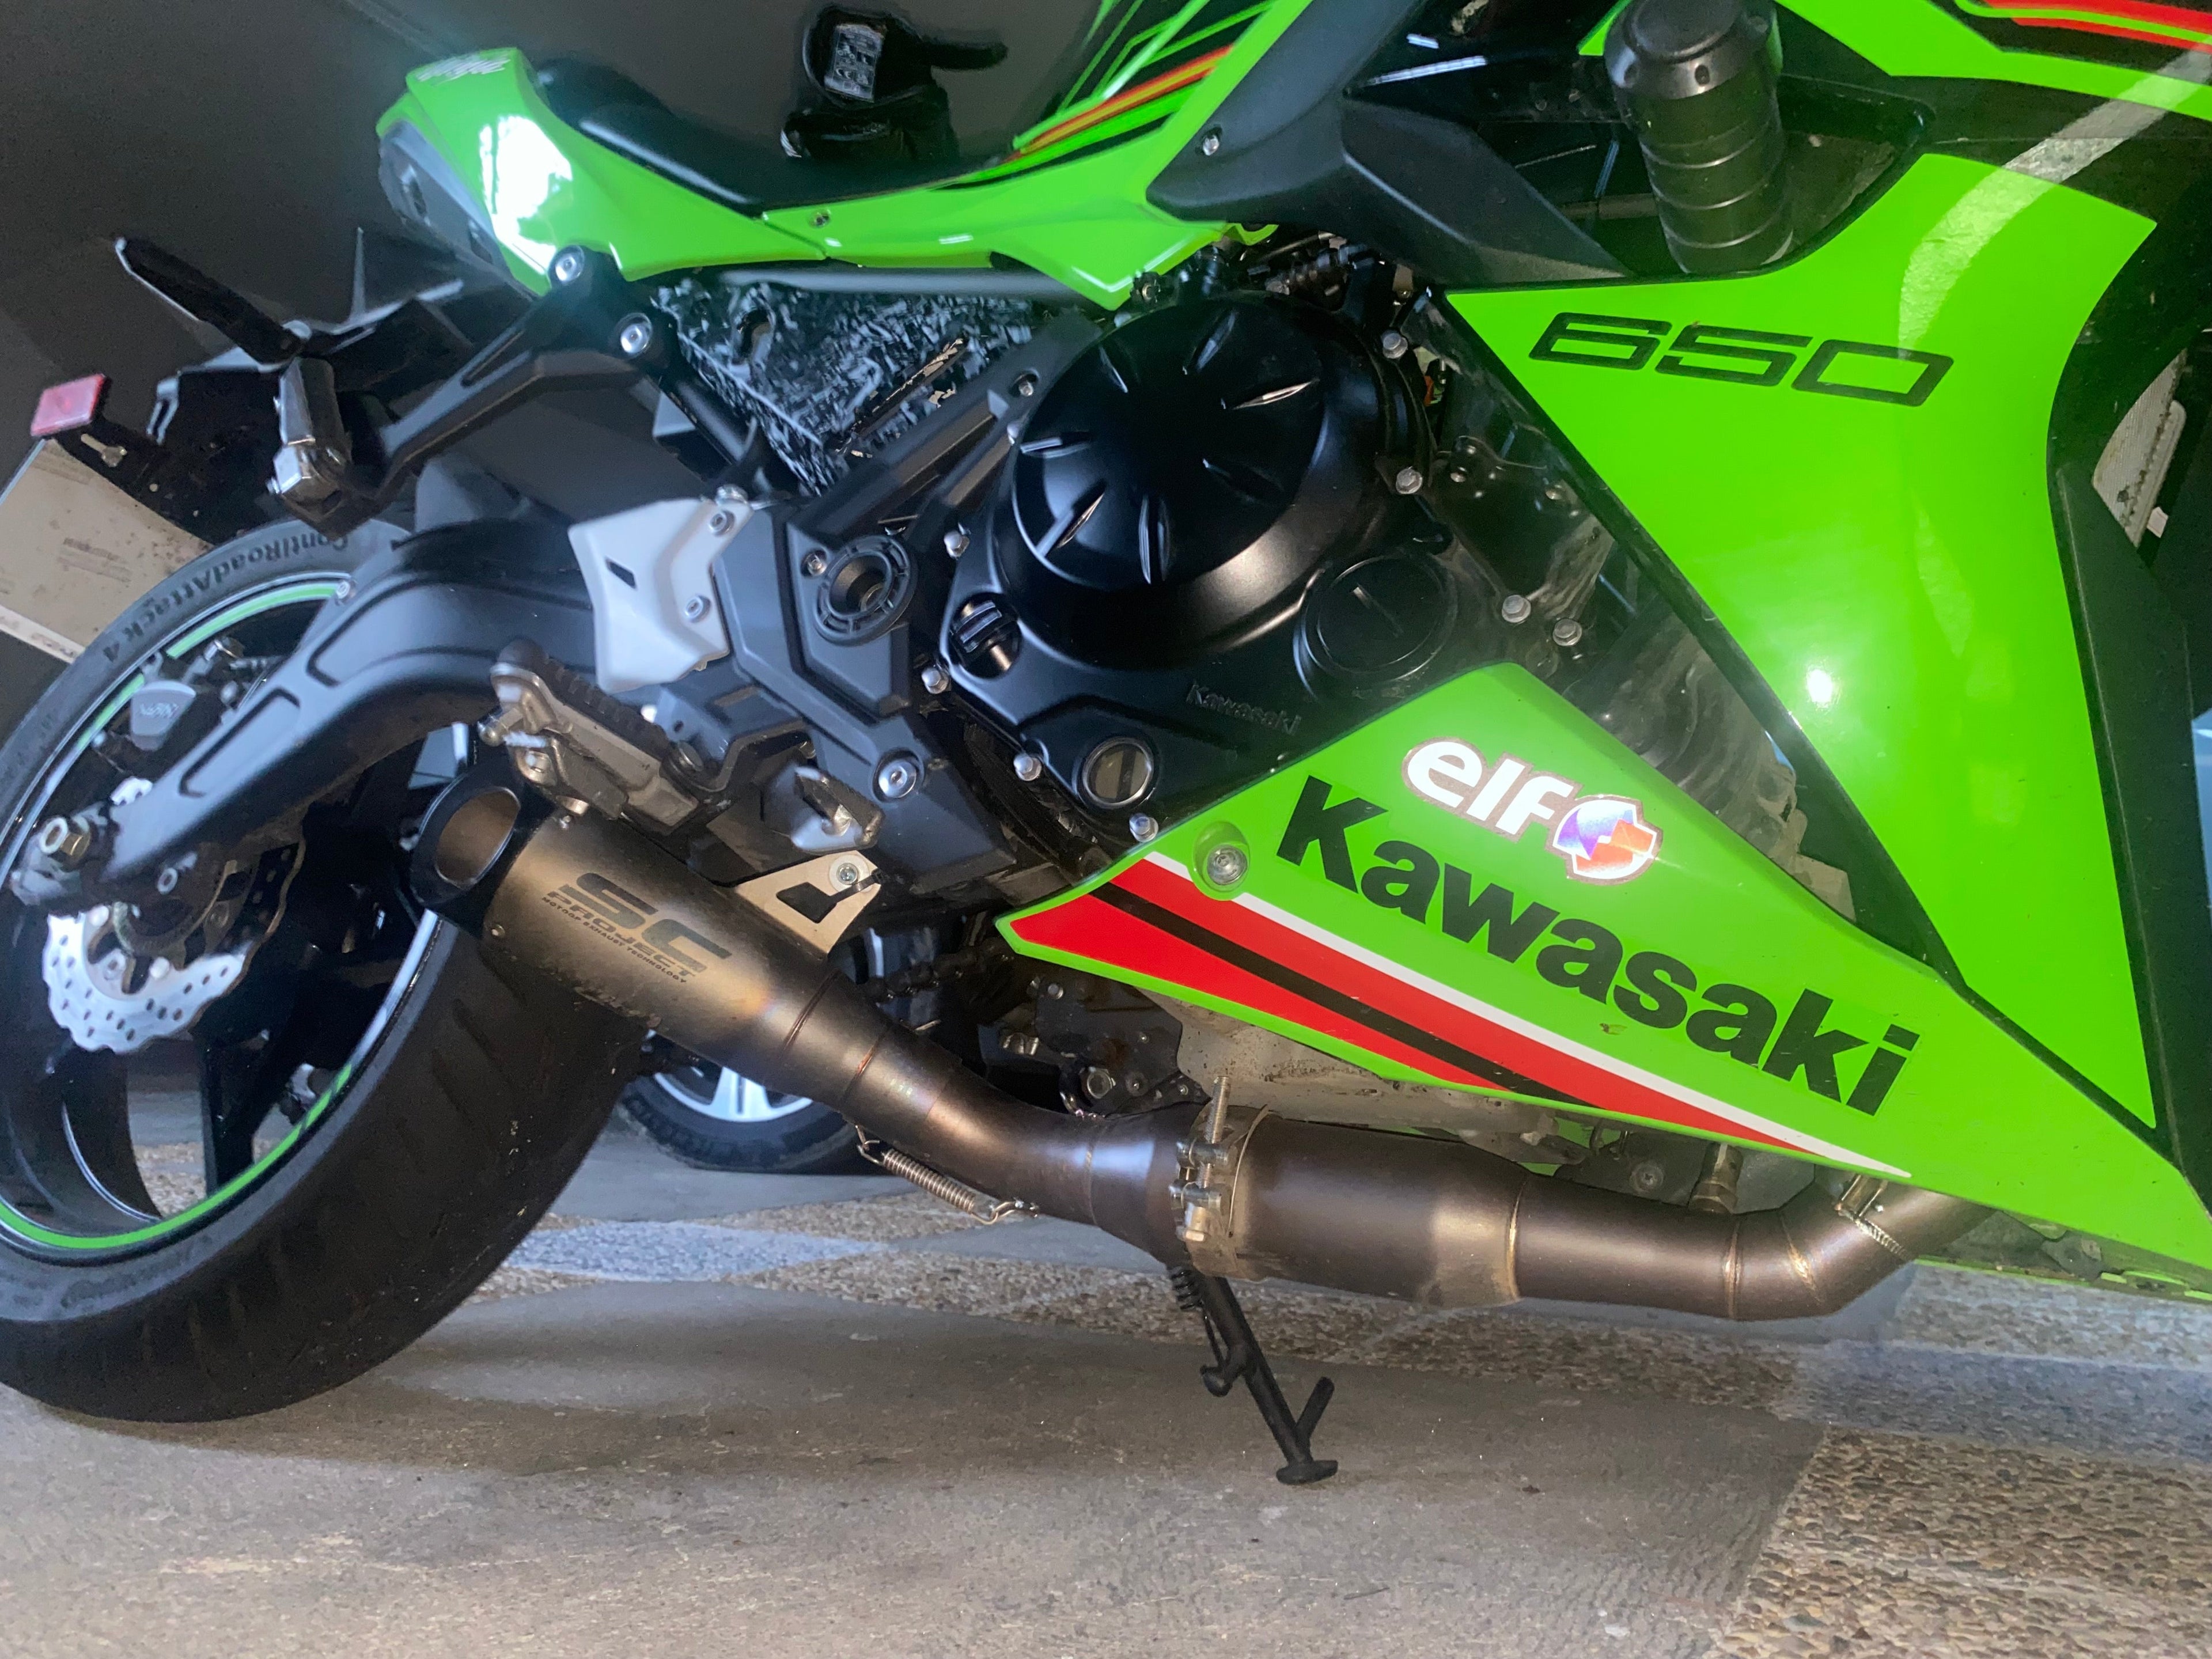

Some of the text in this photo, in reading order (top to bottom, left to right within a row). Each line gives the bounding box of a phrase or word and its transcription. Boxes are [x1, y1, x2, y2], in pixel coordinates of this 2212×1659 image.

[1528, 312, 1954, 407] 650
[1186, 682, 1302, 736] Kawasaki
[1407, 741, 1574, 835] elf
[541, 896, 687, 983] MOTOGP EXHAUST TECHNOLOGY
[547, 890, 696, 977] PROJECT
[558, 872, 732, 973] SC
[1276, 775, 1921, 1116] Kawasaki
